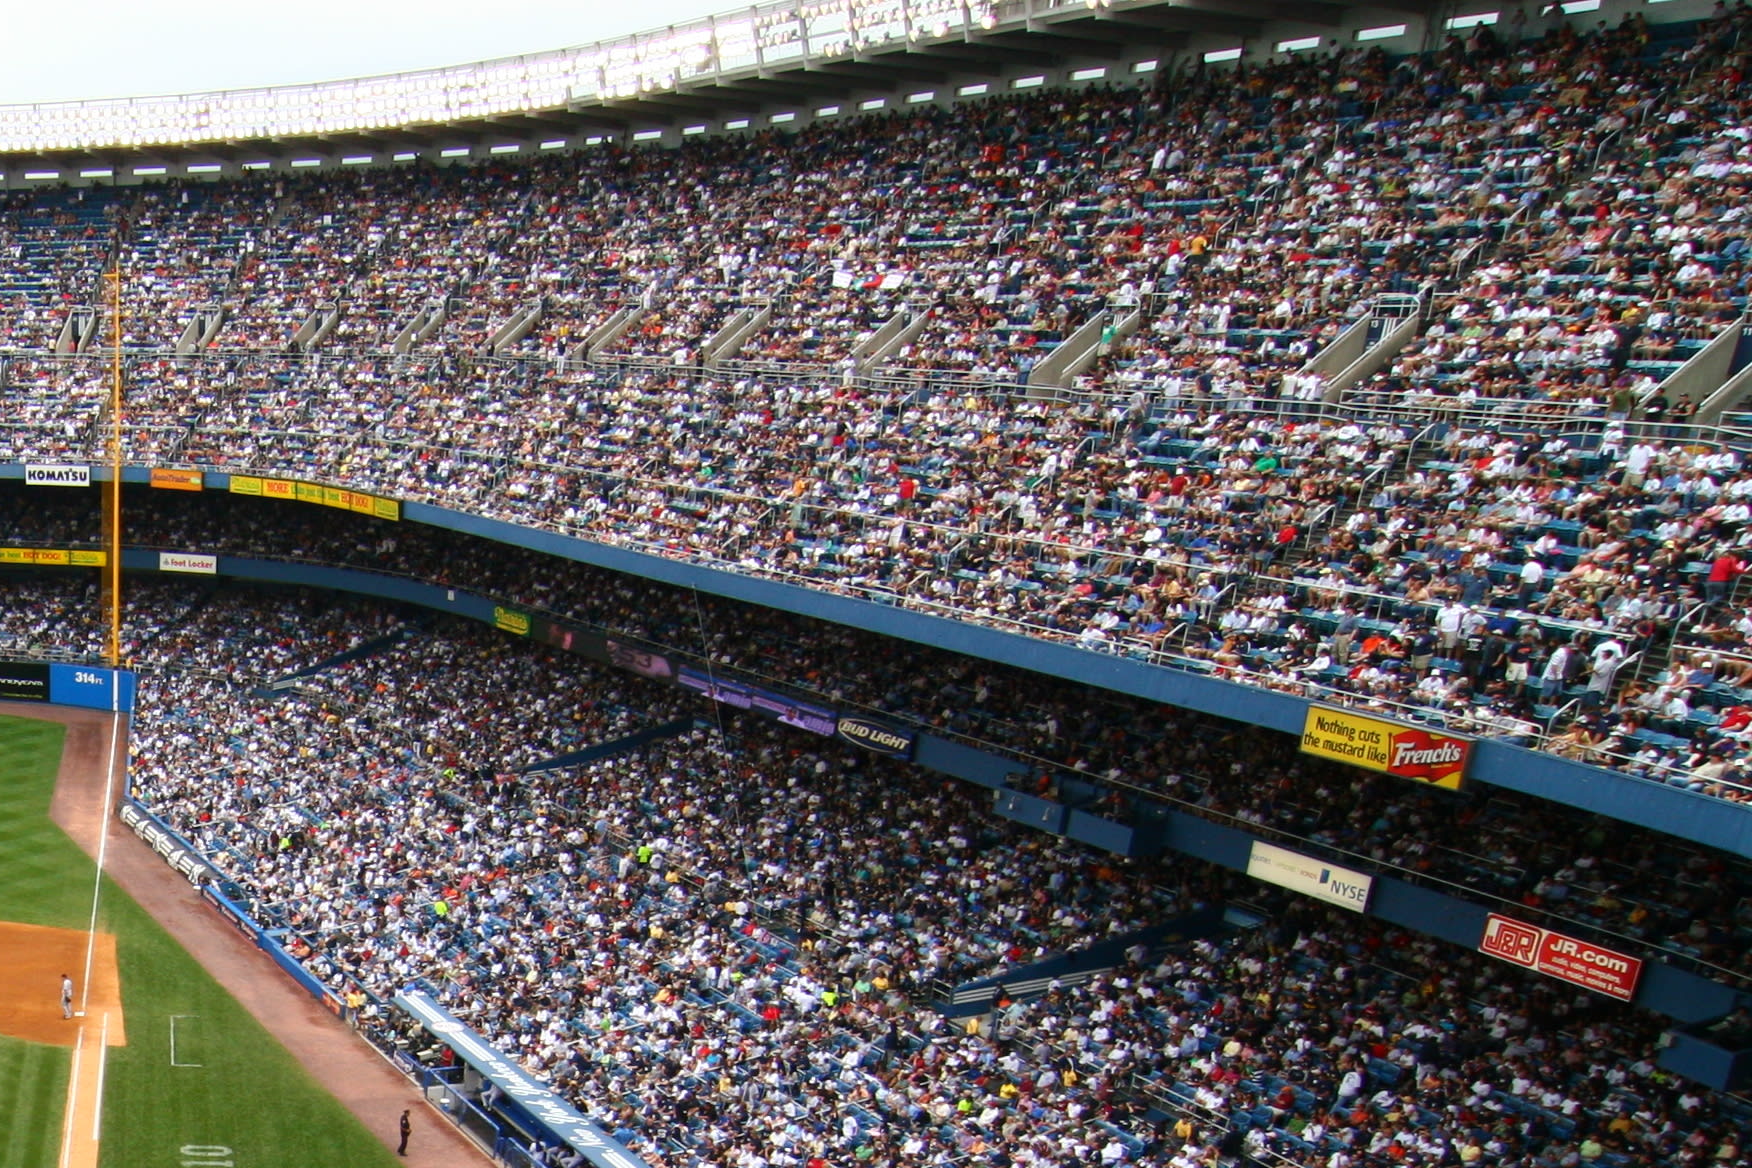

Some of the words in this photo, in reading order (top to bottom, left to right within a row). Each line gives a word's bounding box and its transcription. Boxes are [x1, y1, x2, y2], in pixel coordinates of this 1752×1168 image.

[28, 468, 88, 482] KOMATSU
[74, 671, 95, 684] 314
[841, 719, 869, 738] BUD
[869, 729, 911, 751] LIGHT
[1315, 716, 1356, 742] Nothing
[1358, 730, 1381, 745] cuts
[1304, 732, 1320, 748] the
[1322, 739, 1365, 759] mustard
[1367, 745, 1388, 765] like
[1392, 741, 1462, 768] French's
[1330, 879, 1367, 903] NYSE
[1485, 921, 1538, 963] J&R
[1550, 938, 1629, 974] JR.com
